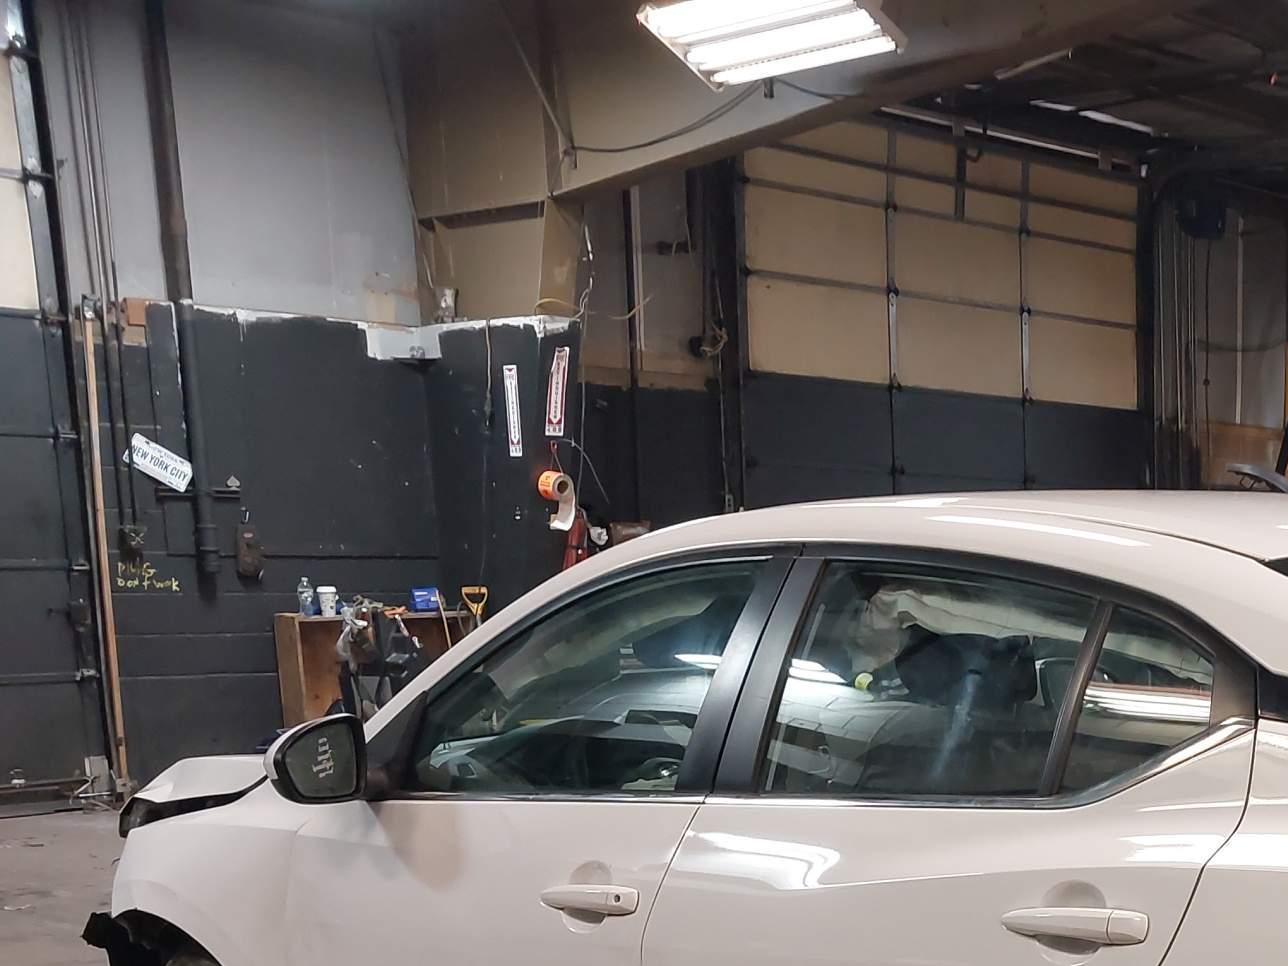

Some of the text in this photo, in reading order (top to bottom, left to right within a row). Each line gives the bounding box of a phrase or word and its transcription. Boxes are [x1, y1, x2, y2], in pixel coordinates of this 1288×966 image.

[131, 443, 150, 461] NEW
[149, 454, 171, 473] YORK
[169, 465, 189, 482] CITY
